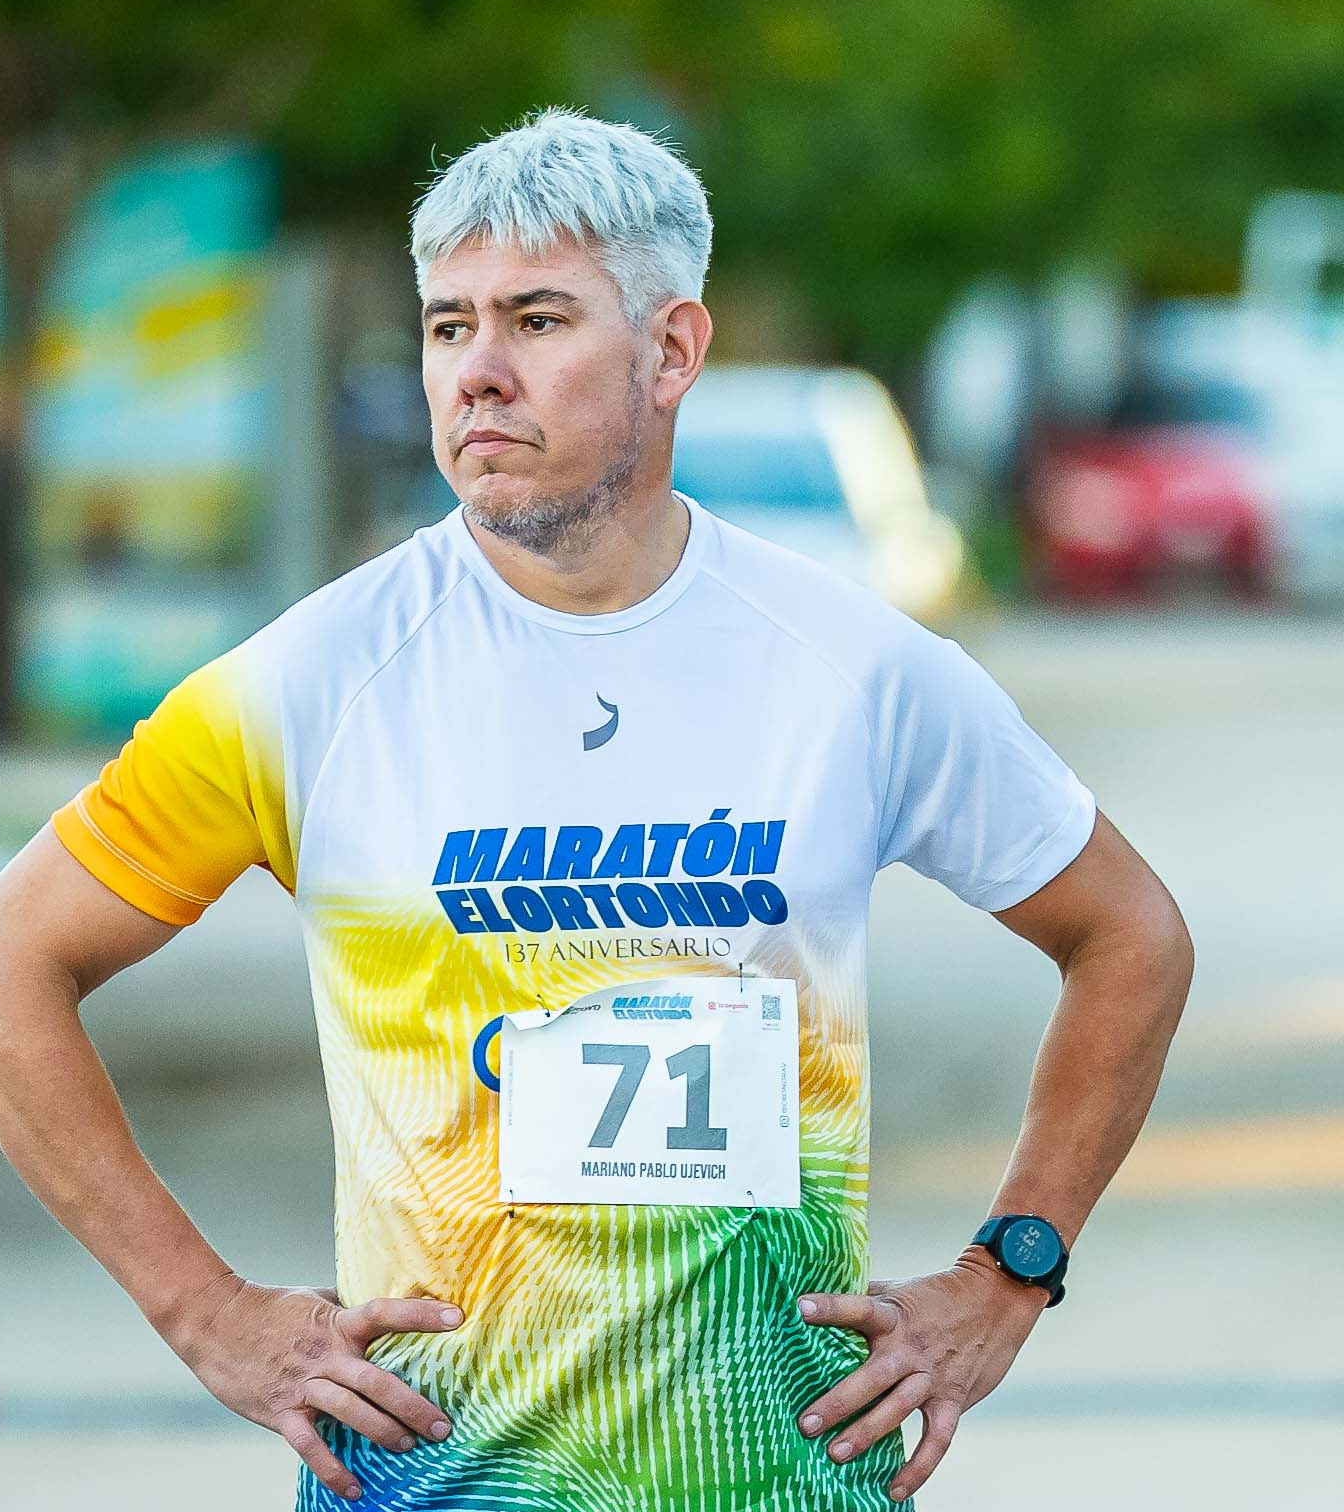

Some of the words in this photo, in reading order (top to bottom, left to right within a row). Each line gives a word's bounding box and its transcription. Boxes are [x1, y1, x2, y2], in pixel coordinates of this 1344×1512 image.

[432, 808, 787, 885] MARATÓN
[436, 879, 788, 934] ELORTONDO
[505, 943, 540, 963] 137
[550, 937, 731, 963] ANIVERSARIO
[612, 993, 694, 1008] MARATÓN
[582, 1043, 728, 1151] 71
[581, 1161, 636, 1178] MARIANO
[639, 1162, 677, 1178] PABLO
[680, 1163, 726, 1180] UJEVICH
